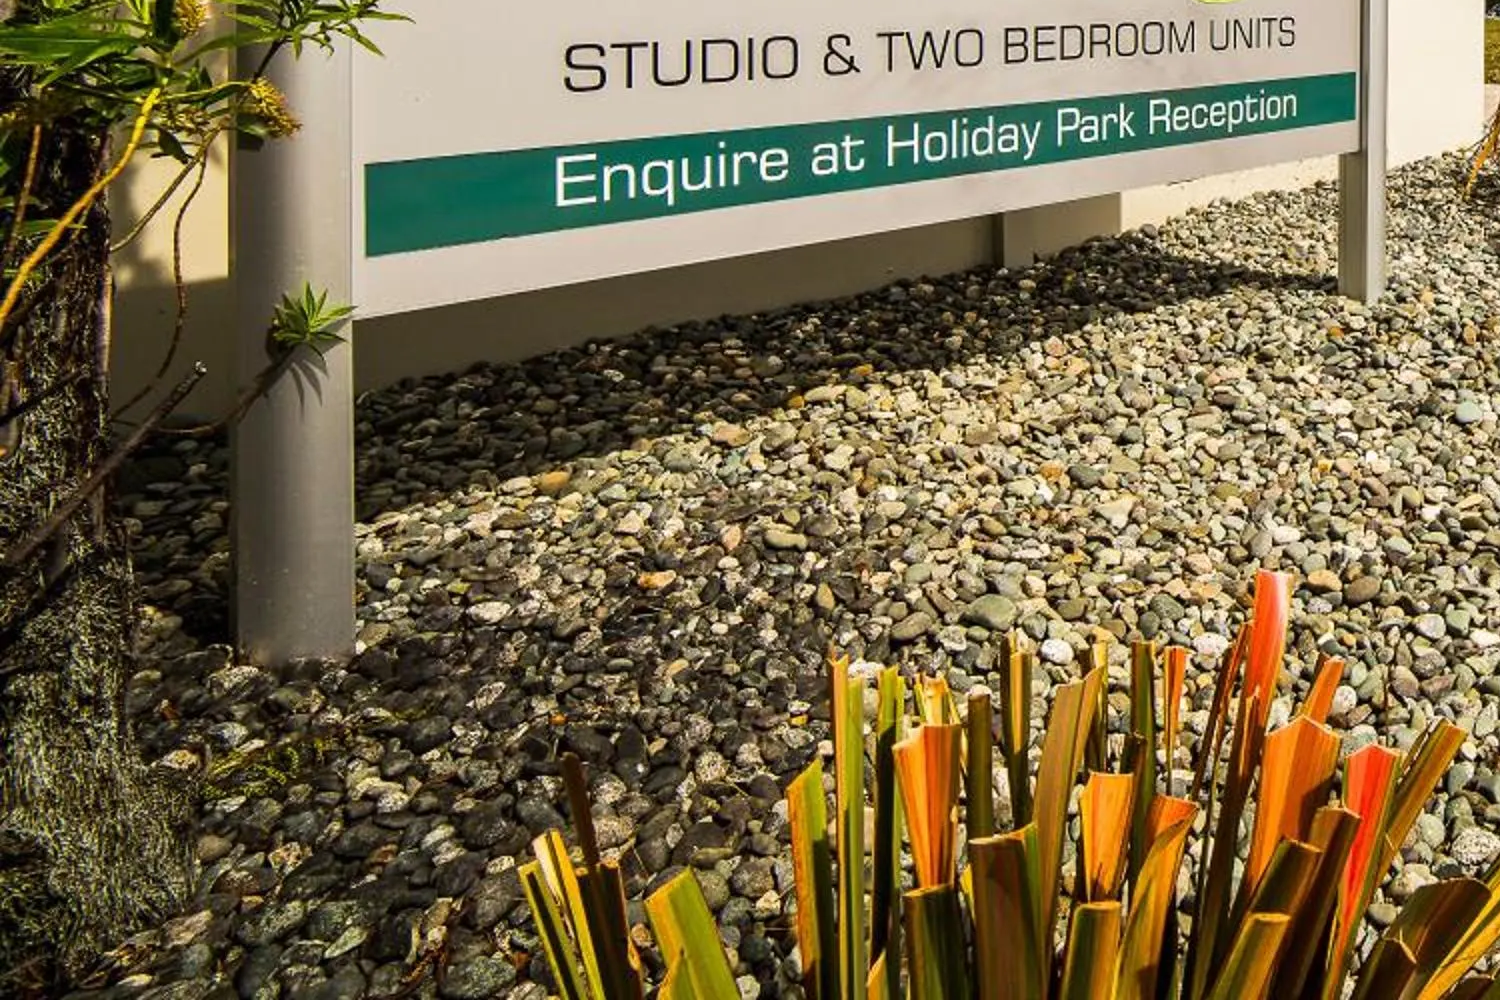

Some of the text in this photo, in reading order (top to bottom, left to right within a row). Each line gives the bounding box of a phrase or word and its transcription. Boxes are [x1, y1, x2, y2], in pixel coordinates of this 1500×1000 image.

[564, 17, 1294, 92] STUDIO & TWO BEDROOM UNITS
[554, 89, 1297, 208] Enquire at Holiday Park Reception
